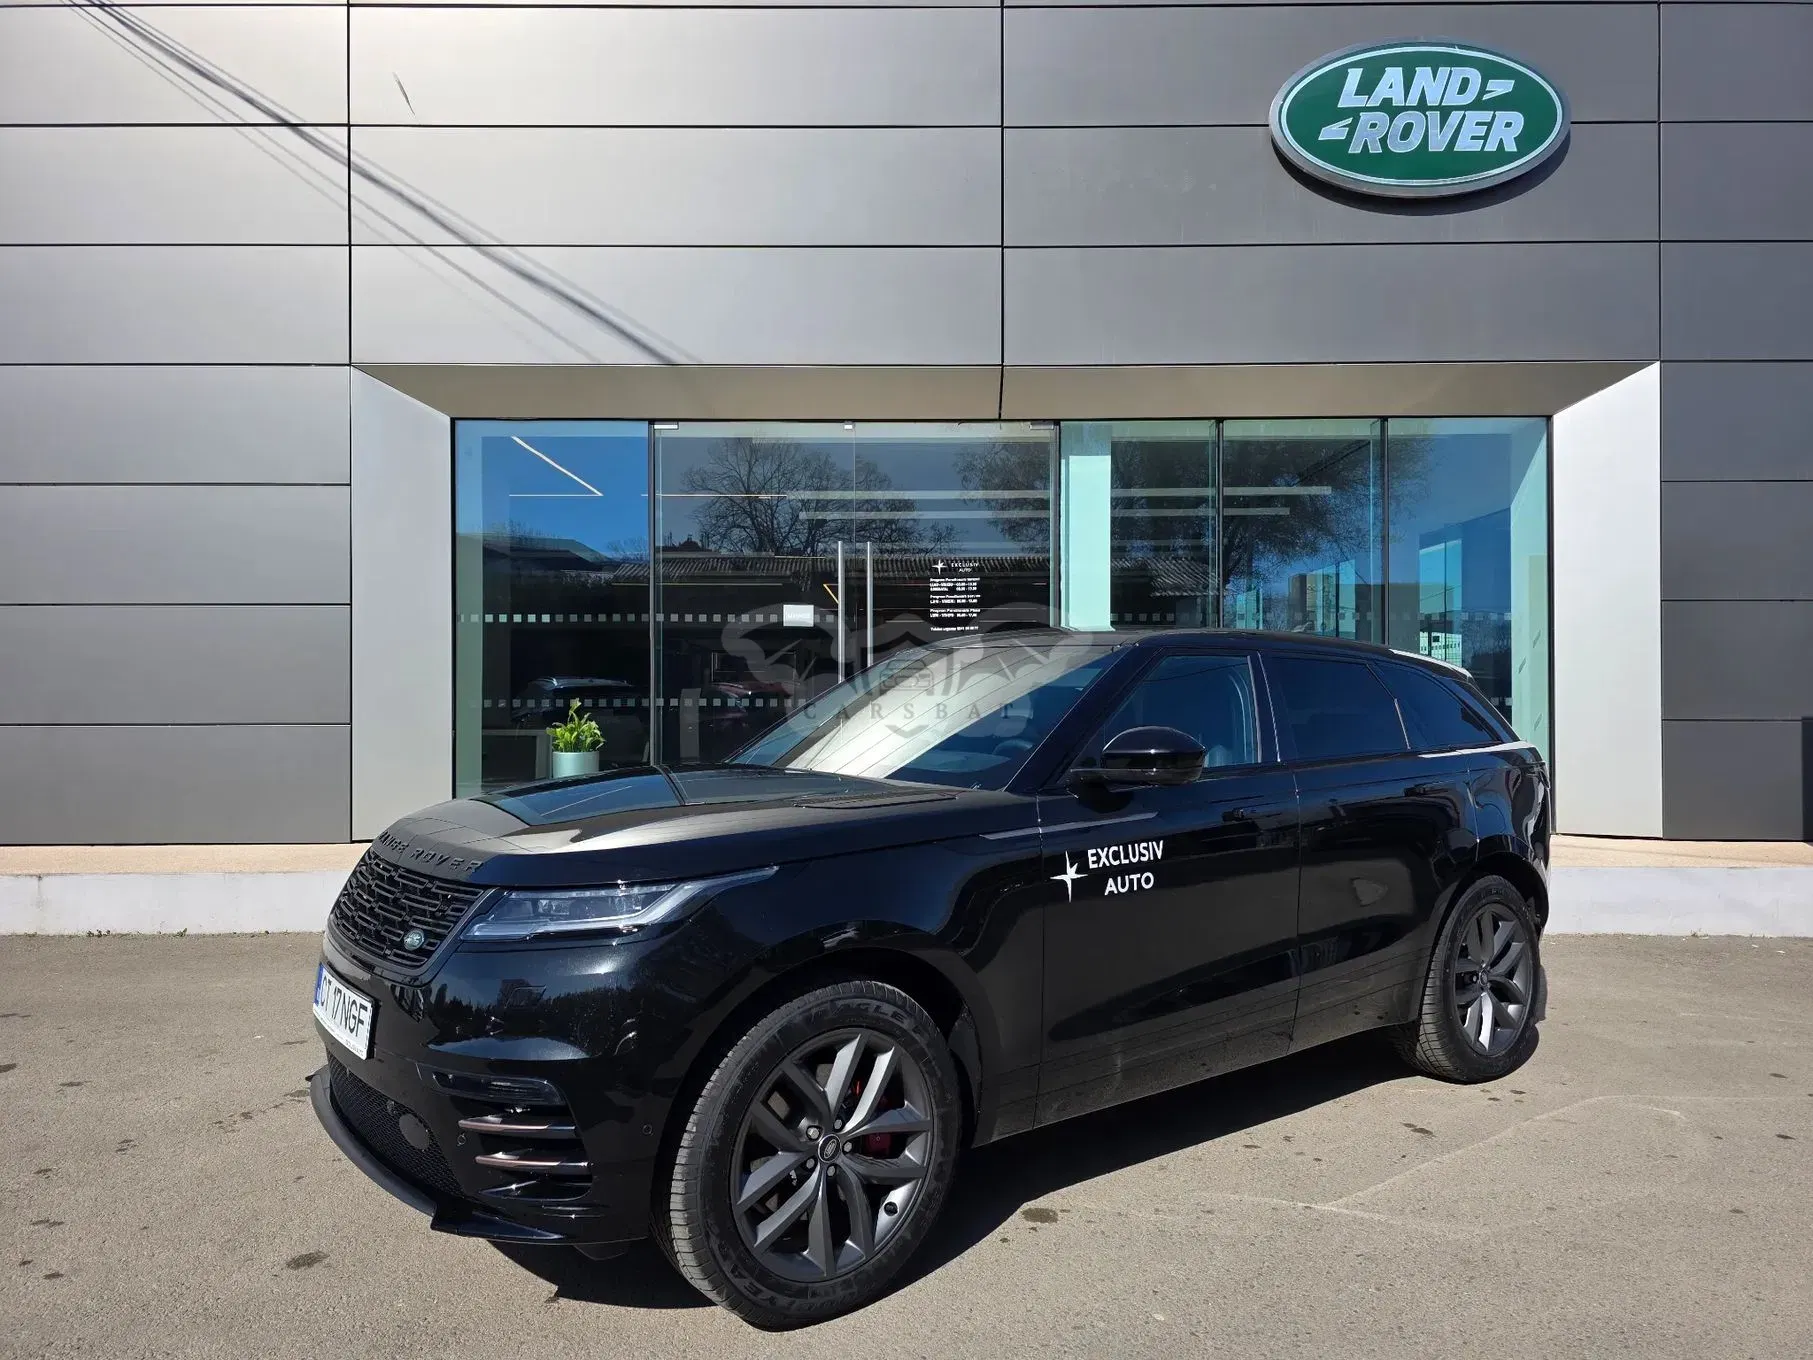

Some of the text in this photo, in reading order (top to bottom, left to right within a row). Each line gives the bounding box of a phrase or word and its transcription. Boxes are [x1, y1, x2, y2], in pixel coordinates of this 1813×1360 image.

[1337, 66, 1482, 107] LAND
[1348, 110, 1525, 154] ROVER
[379, 830, 484, 873] ANGE ROVER
[1087, 840, 1164, 869] EXCLUSIV
[1104, 871, 1155, 896] AUTO
